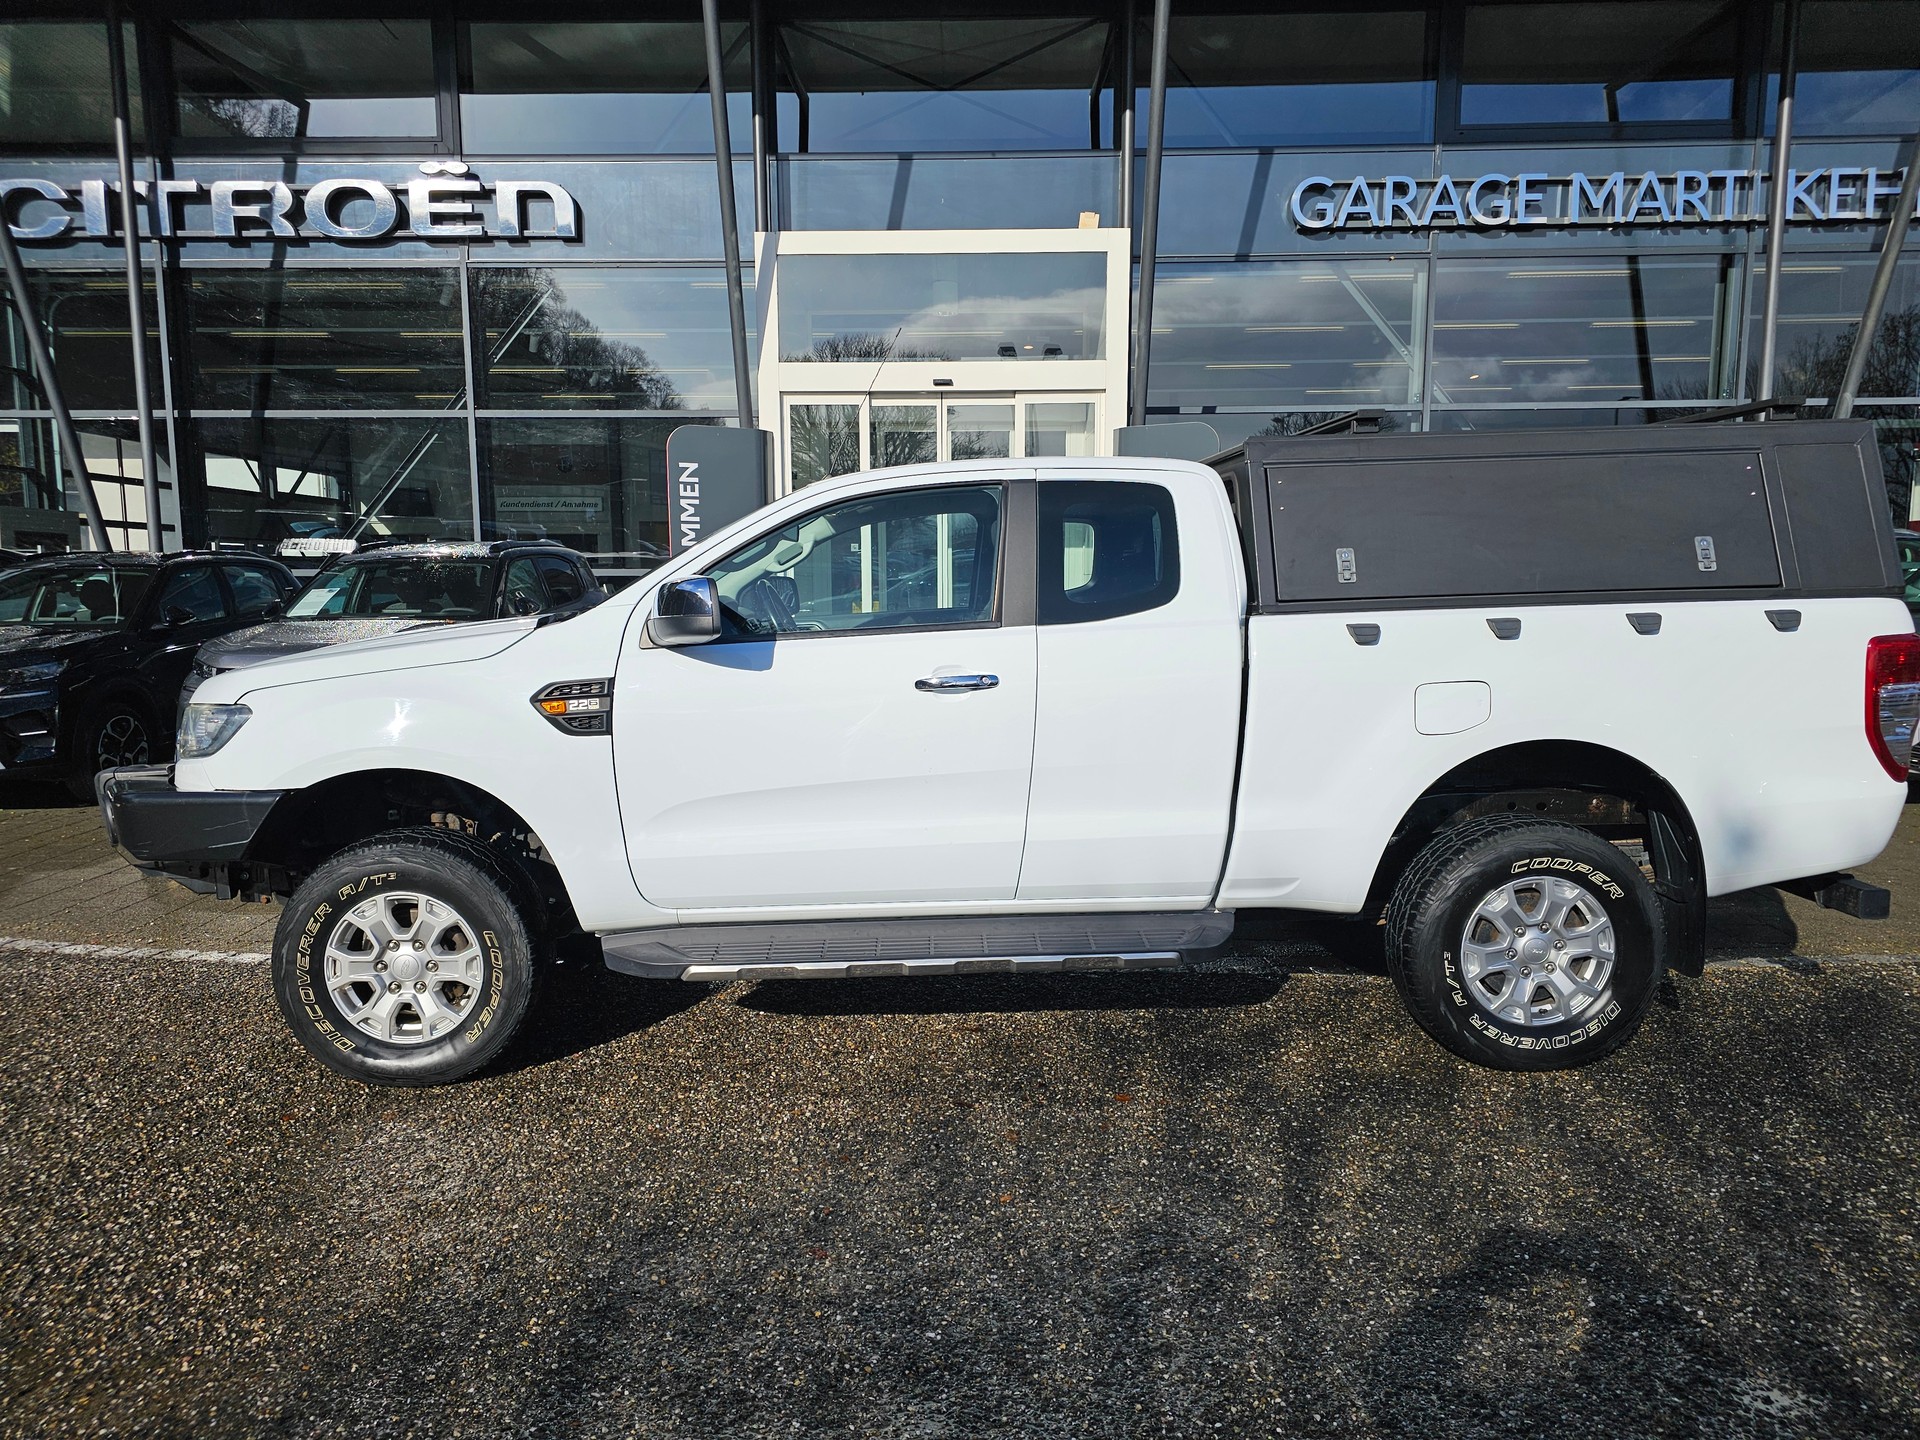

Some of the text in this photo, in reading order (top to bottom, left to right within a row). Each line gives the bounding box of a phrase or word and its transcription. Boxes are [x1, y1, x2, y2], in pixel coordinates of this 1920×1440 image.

[1291, 166, 1920, 228] GARAGE MARTI KEH
[500, 500, 554, 508] Kundendienst
[561, 500, 599, 508] Annahme
[1511, 857, 1625, 900] COOPER
[296, 903, 356, 1053] DISCOVERER
[465, 930, 504, 1044] COOPER
[1469, 1000, 1622, 1050] DISCOVERER
